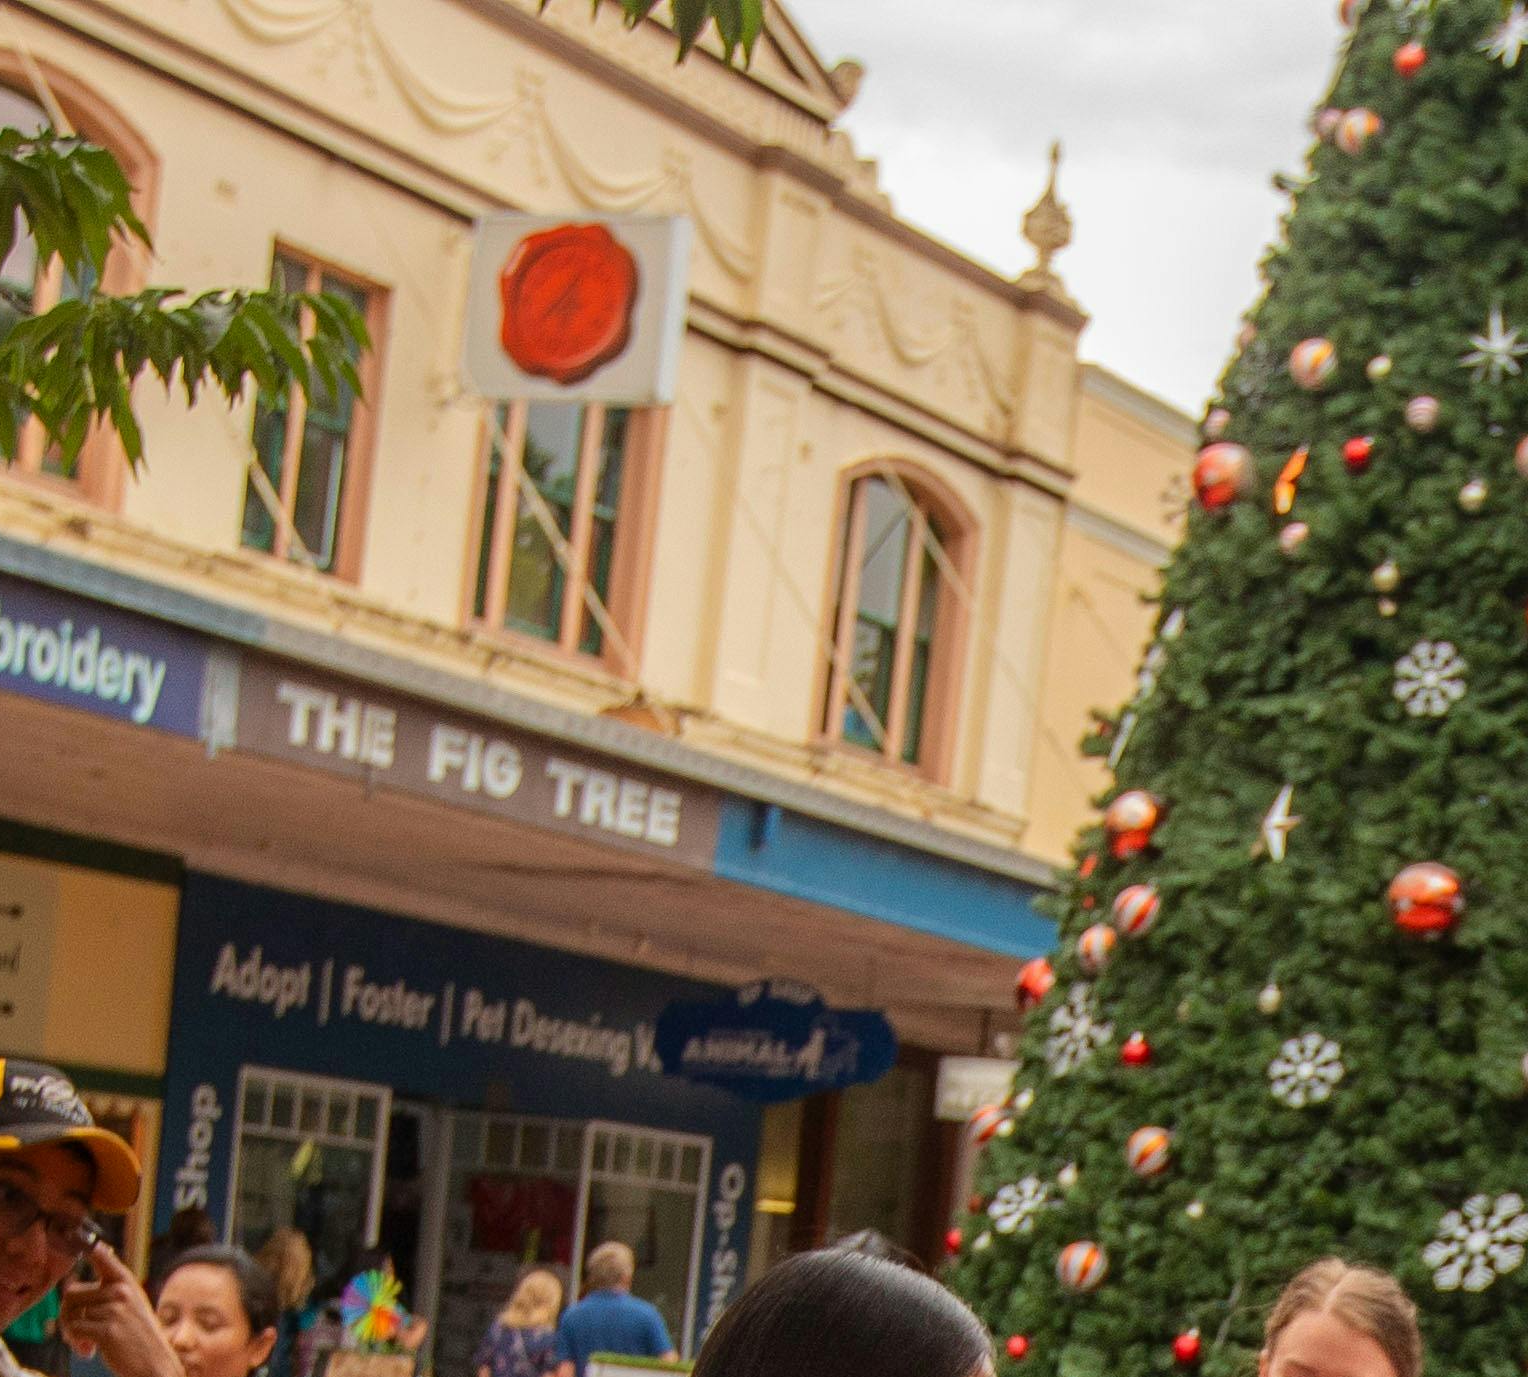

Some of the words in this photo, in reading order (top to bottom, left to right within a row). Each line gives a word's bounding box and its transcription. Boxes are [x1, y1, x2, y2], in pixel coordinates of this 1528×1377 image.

[277, 680, 397, 771] THE
[428, 722, 523, 799] FIG
[545, 760, 681, 847] TREE
[209, 941, 311, 1020] Adopt
[340, 963, 436, 1030] Foster
[461, 990, 507, 1042] Pet
[509, 999, 633, 1079] Desexing
[173, 1082, 222, 1210] Shop
